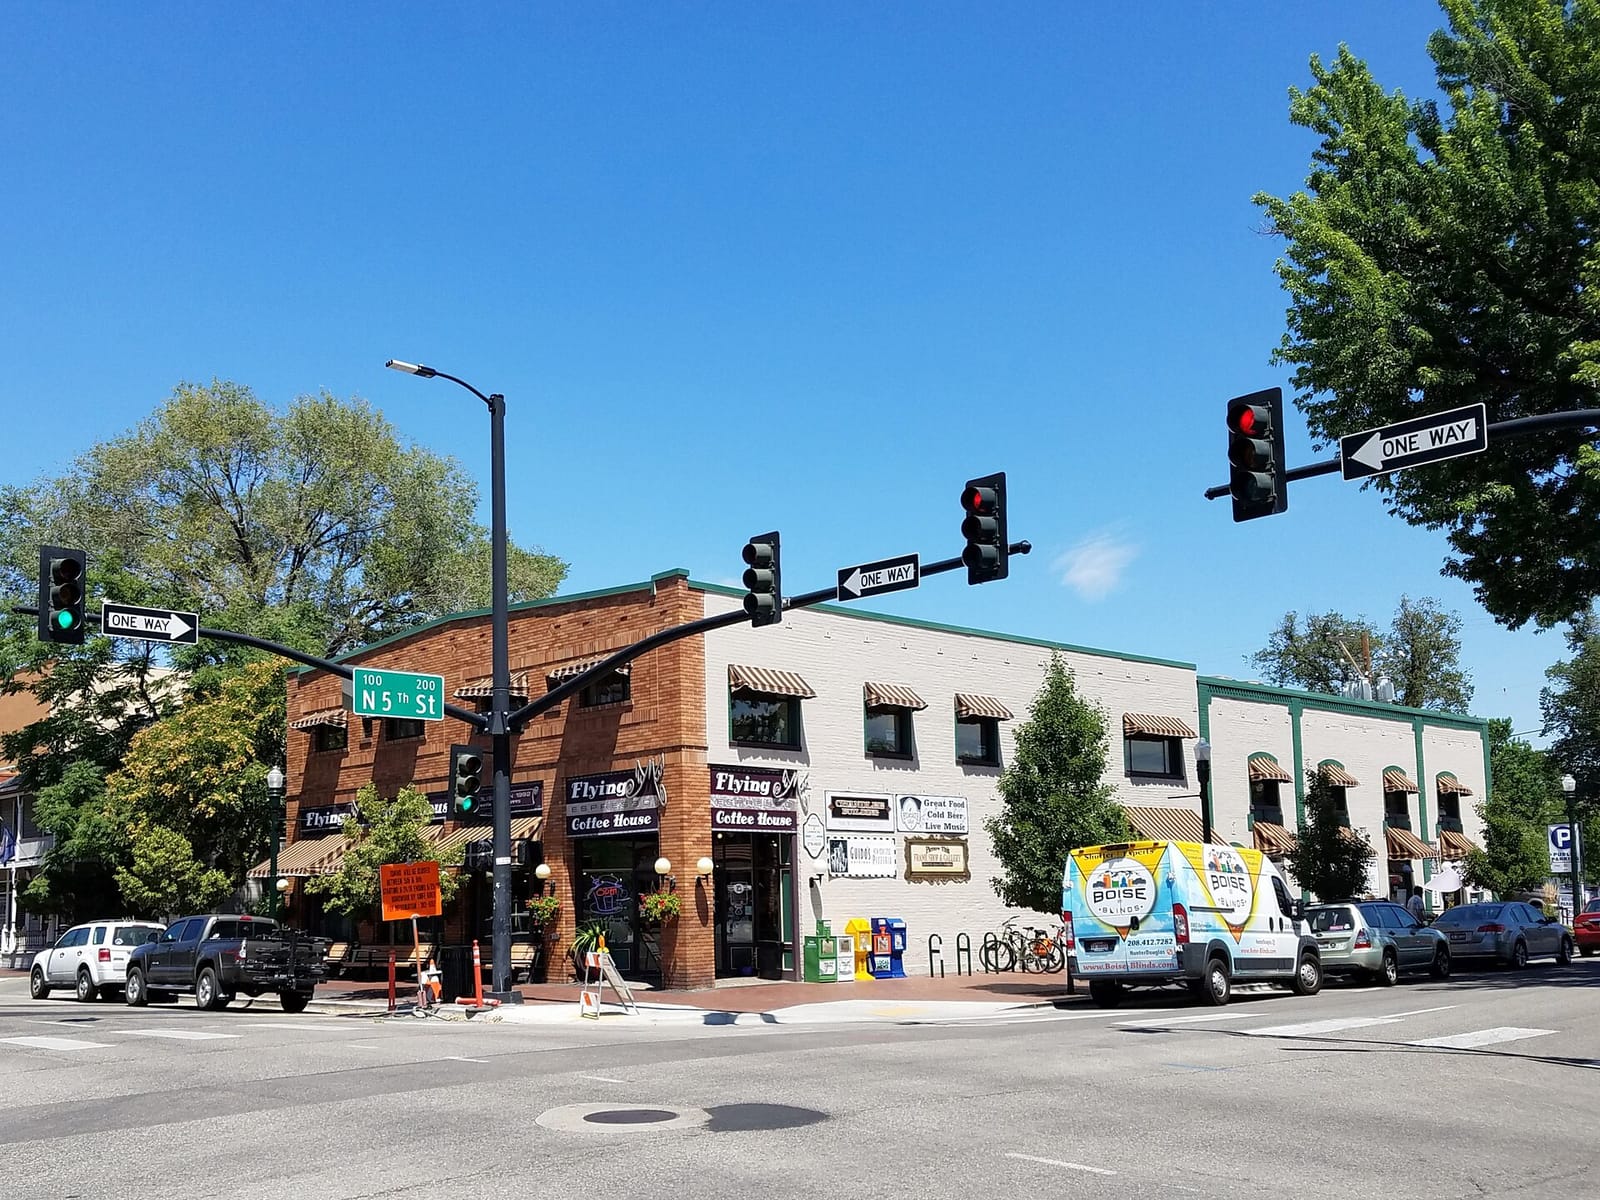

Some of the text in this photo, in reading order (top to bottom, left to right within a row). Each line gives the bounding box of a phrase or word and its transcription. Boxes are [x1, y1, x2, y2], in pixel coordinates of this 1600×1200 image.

[1383, 421, 1470, 457] ONE WAY
[860, 565, 911, 587] ONE WAY
[112, 614, 170, 631] ONE WAY
[362, 674, 382, 686] 100
[416, 679, 436, 691] 200
[362, 689, 376, 711] N
[382, 691, 392, 712] 5
[415, 694, 436, 715] St
[571, 780, 627, 800] Flying
[715, 772, 771, 796] Flying
[923, 799, 965, 809] Great Food
[305, 811, 346, 827] Flying
[571, 813, 652, 831] Coffee House
[716, 810, 793, 826] Coffee House
[927, 810, 945, 819] Cold
[925, 822, 966, 831] Live Music
[1557, 829, 1571, 848] P
[1211, 874, 1247, 893] BOISE
[1093, 887, 1147, 904] BOISE
[1102, 904, 1140, 914] BLINDS
[1127, 938, 1173, 947] 208.412.7282
